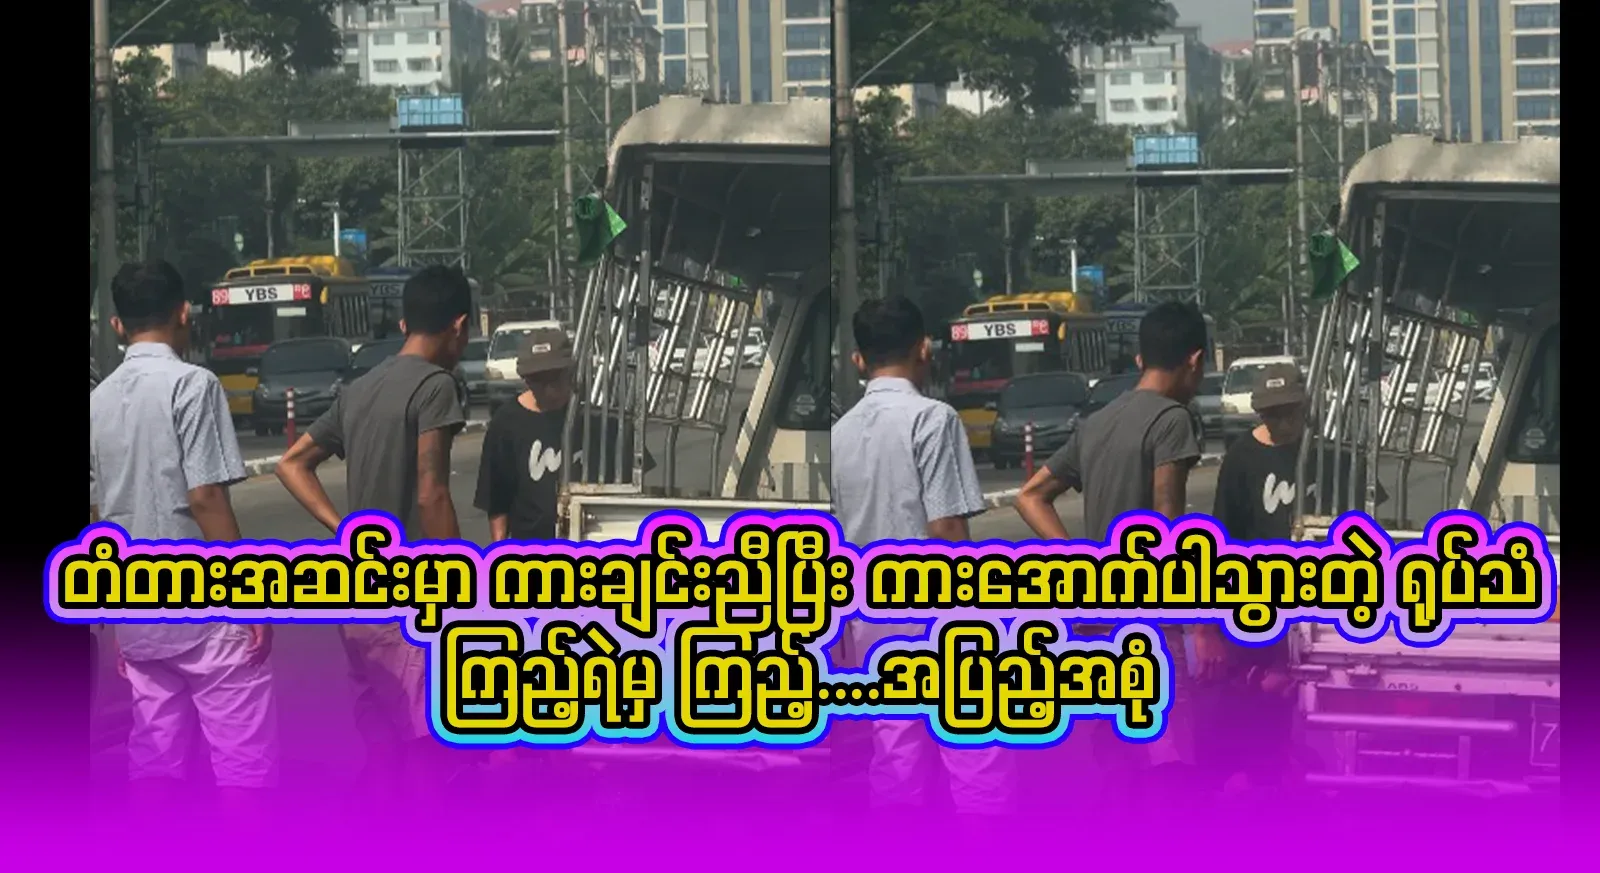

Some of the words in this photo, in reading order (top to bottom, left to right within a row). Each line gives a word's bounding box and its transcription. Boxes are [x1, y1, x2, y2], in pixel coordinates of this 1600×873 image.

[245, 287, 278, 301] YBS
[369, 284, 400, 296] YBS
[983, 322, 1016, 337] YBS
